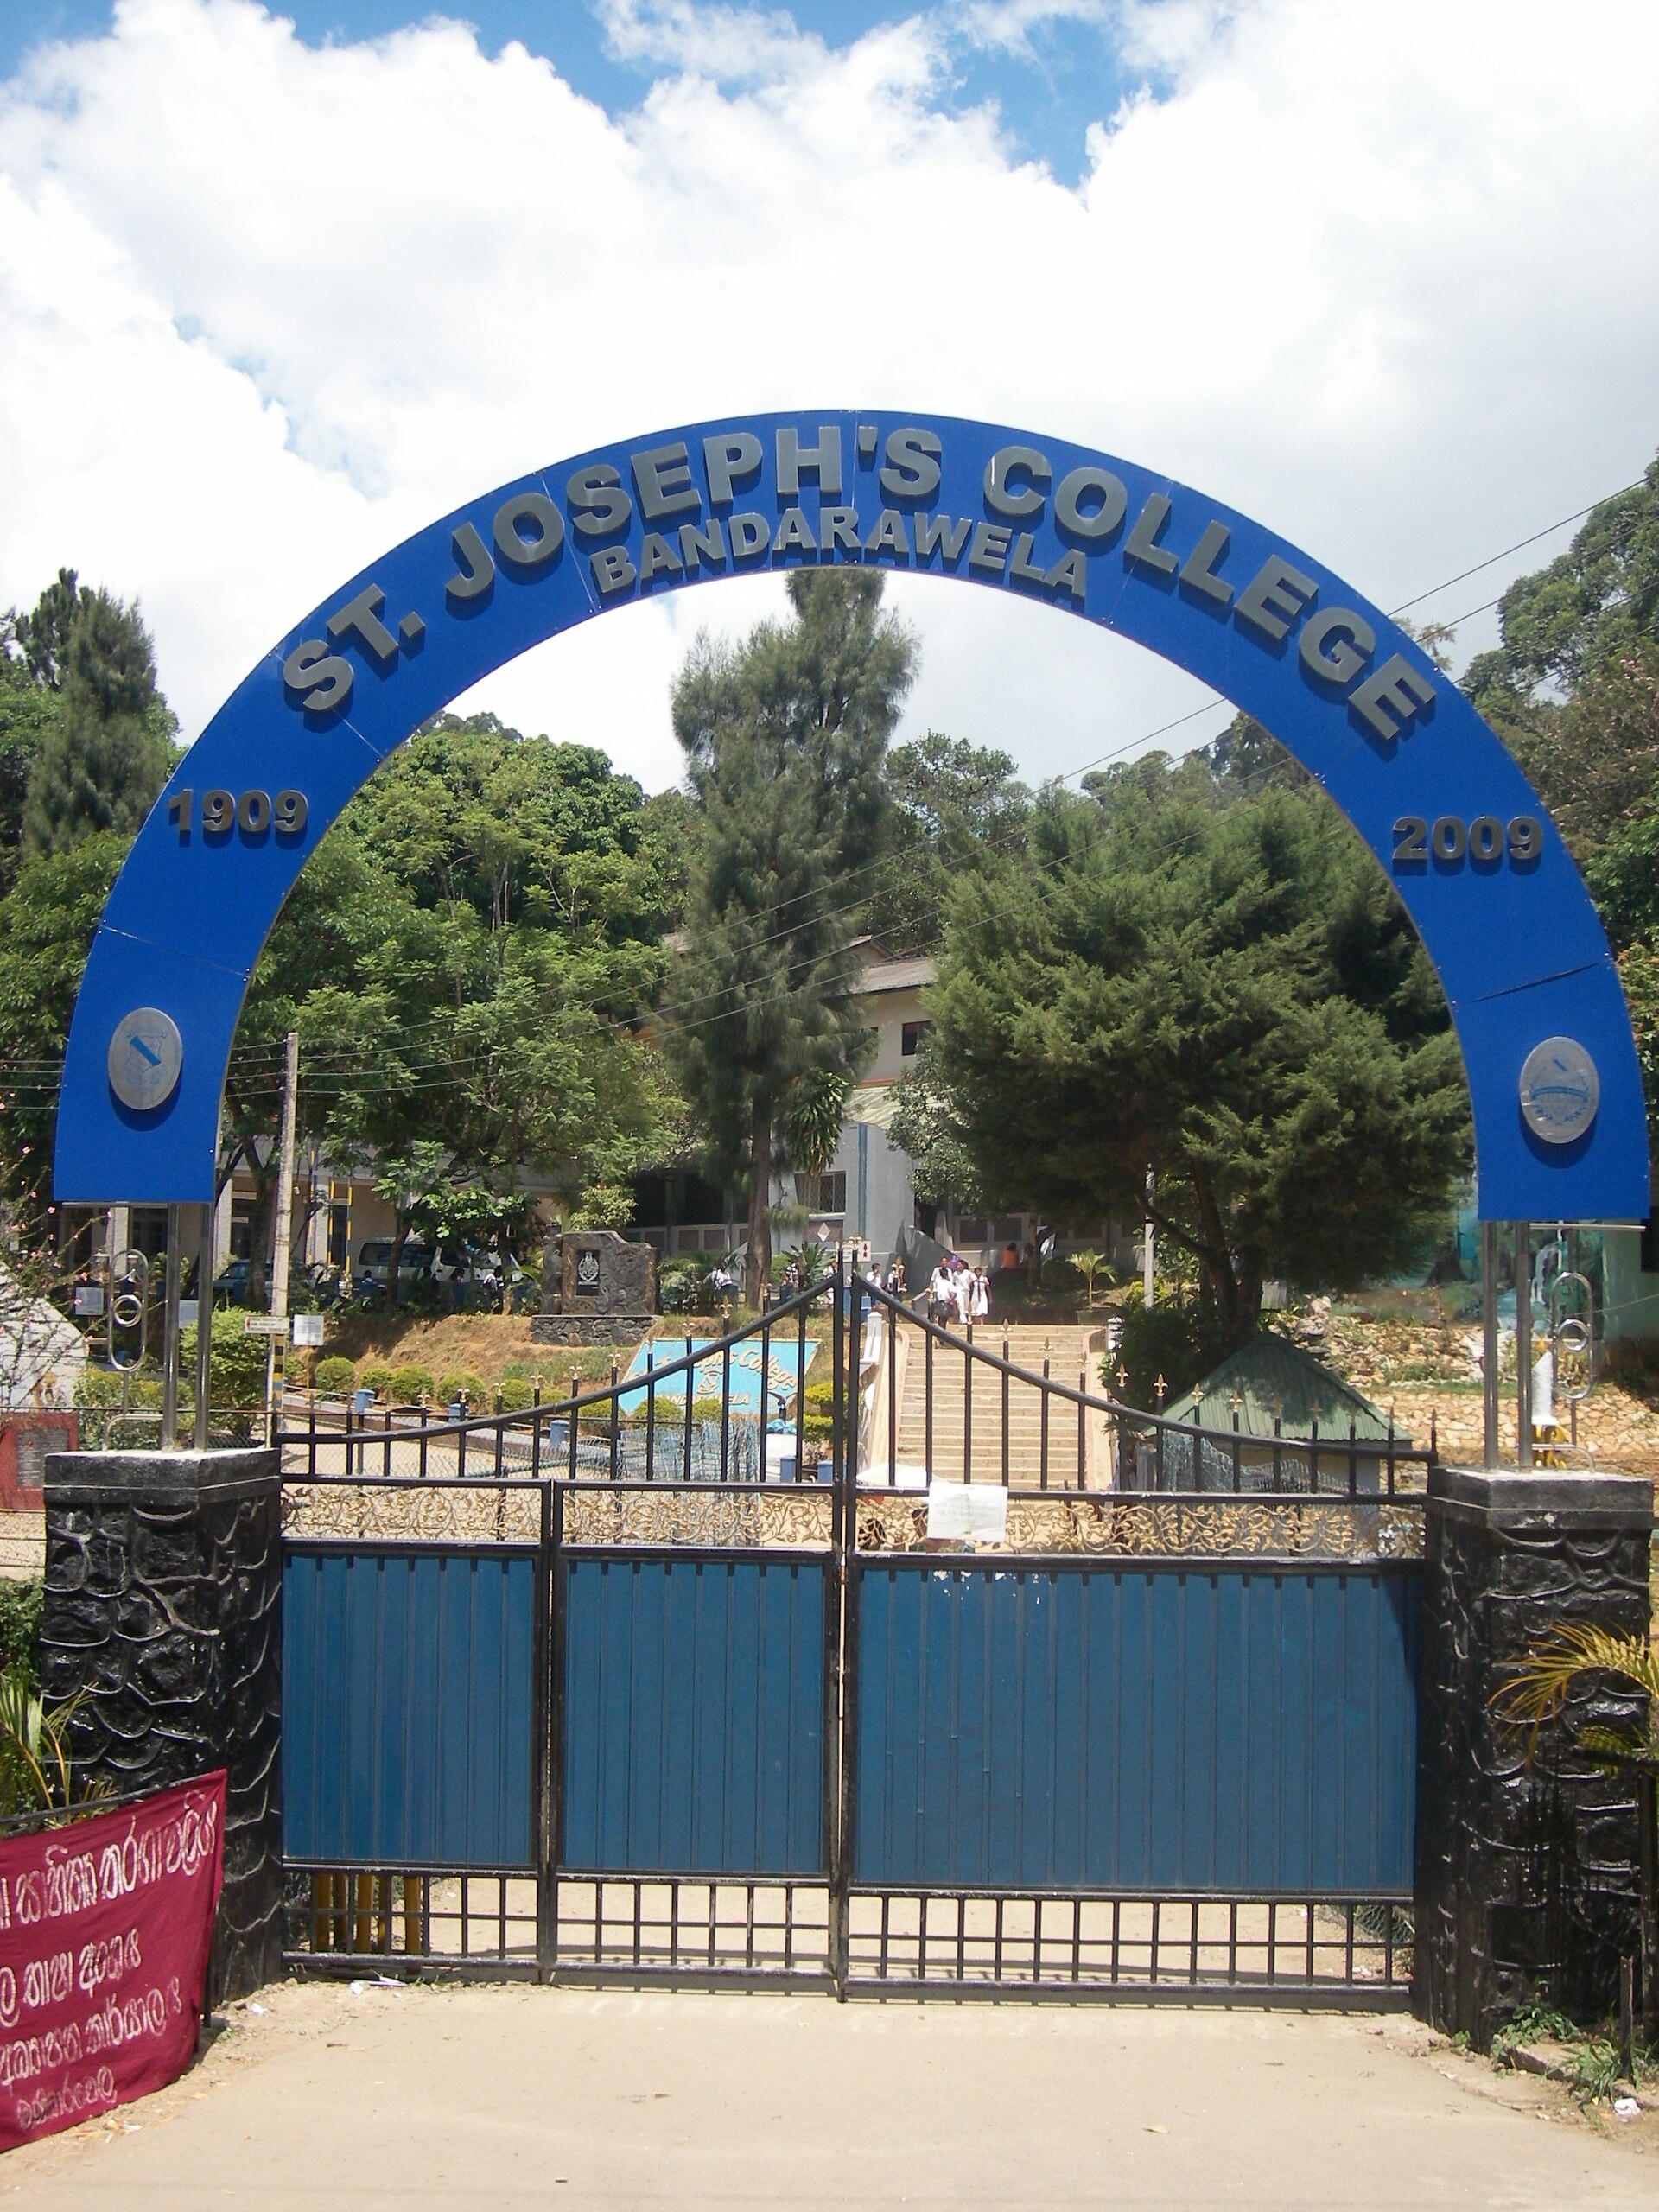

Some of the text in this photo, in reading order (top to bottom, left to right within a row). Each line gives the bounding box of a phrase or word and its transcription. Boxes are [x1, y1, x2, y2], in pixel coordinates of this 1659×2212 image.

[283, 424, 1437, 741] ST. JOSEPH'S COLLEGE
[590, 506, 1087, 597] BANDARAWELA
[168, 788, 309, 832] 1909
[1392, 815, 1543, 860] 2009
